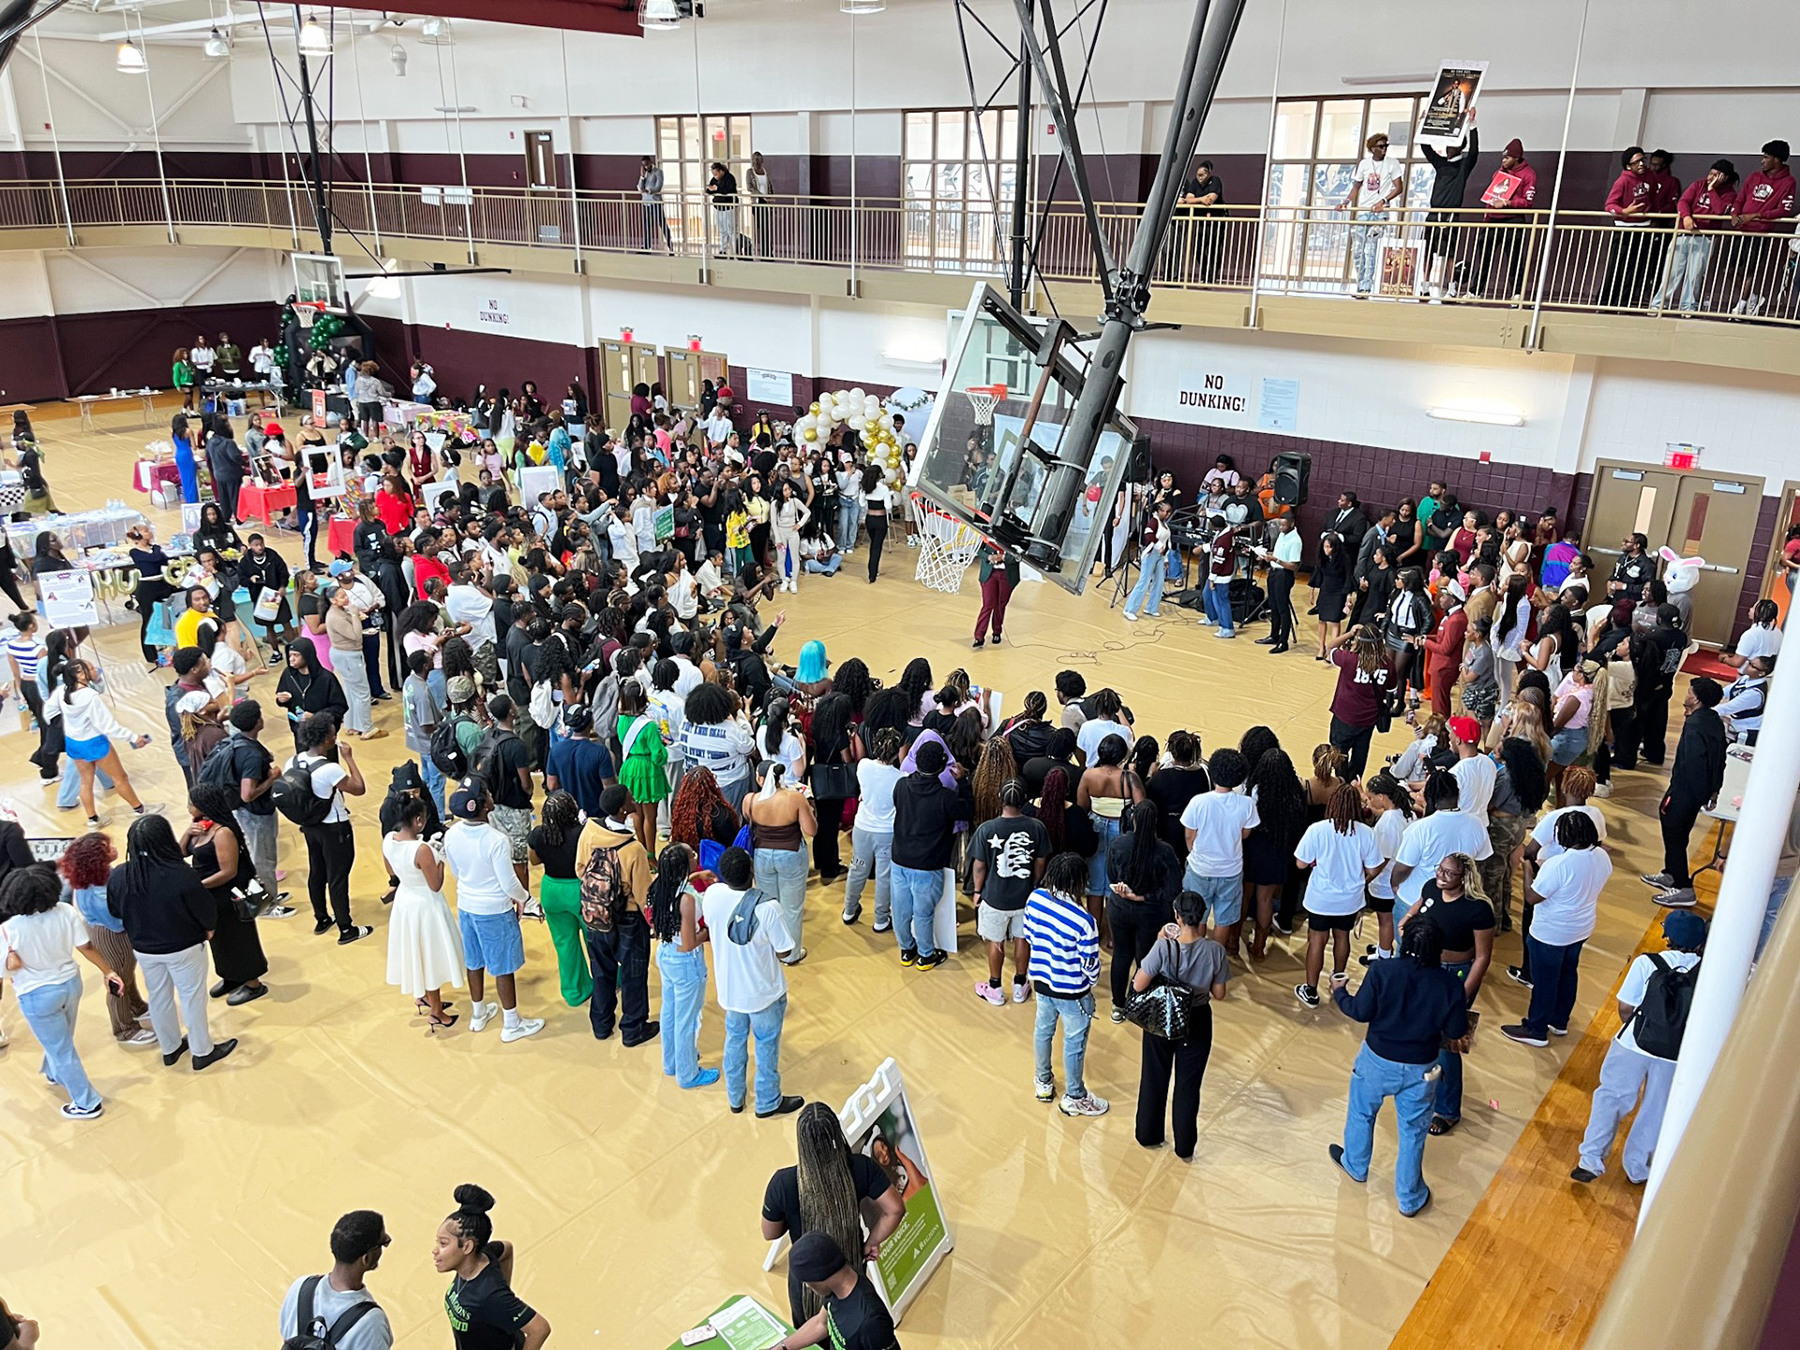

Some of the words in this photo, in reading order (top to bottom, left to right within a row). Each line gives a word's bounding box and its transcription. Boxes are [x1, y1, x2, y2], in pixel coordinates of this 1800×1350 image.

[488, 299, 498, 310] NO
[480, 311, 510, 324] DUNKING!
[1204, 374, 1224, 390] NO
[1179, 390, 1246, 412] DUNKING!
[879, 1240, 895, 1260] YOUR
[893, 1221, 911, 1243] VOICE.
